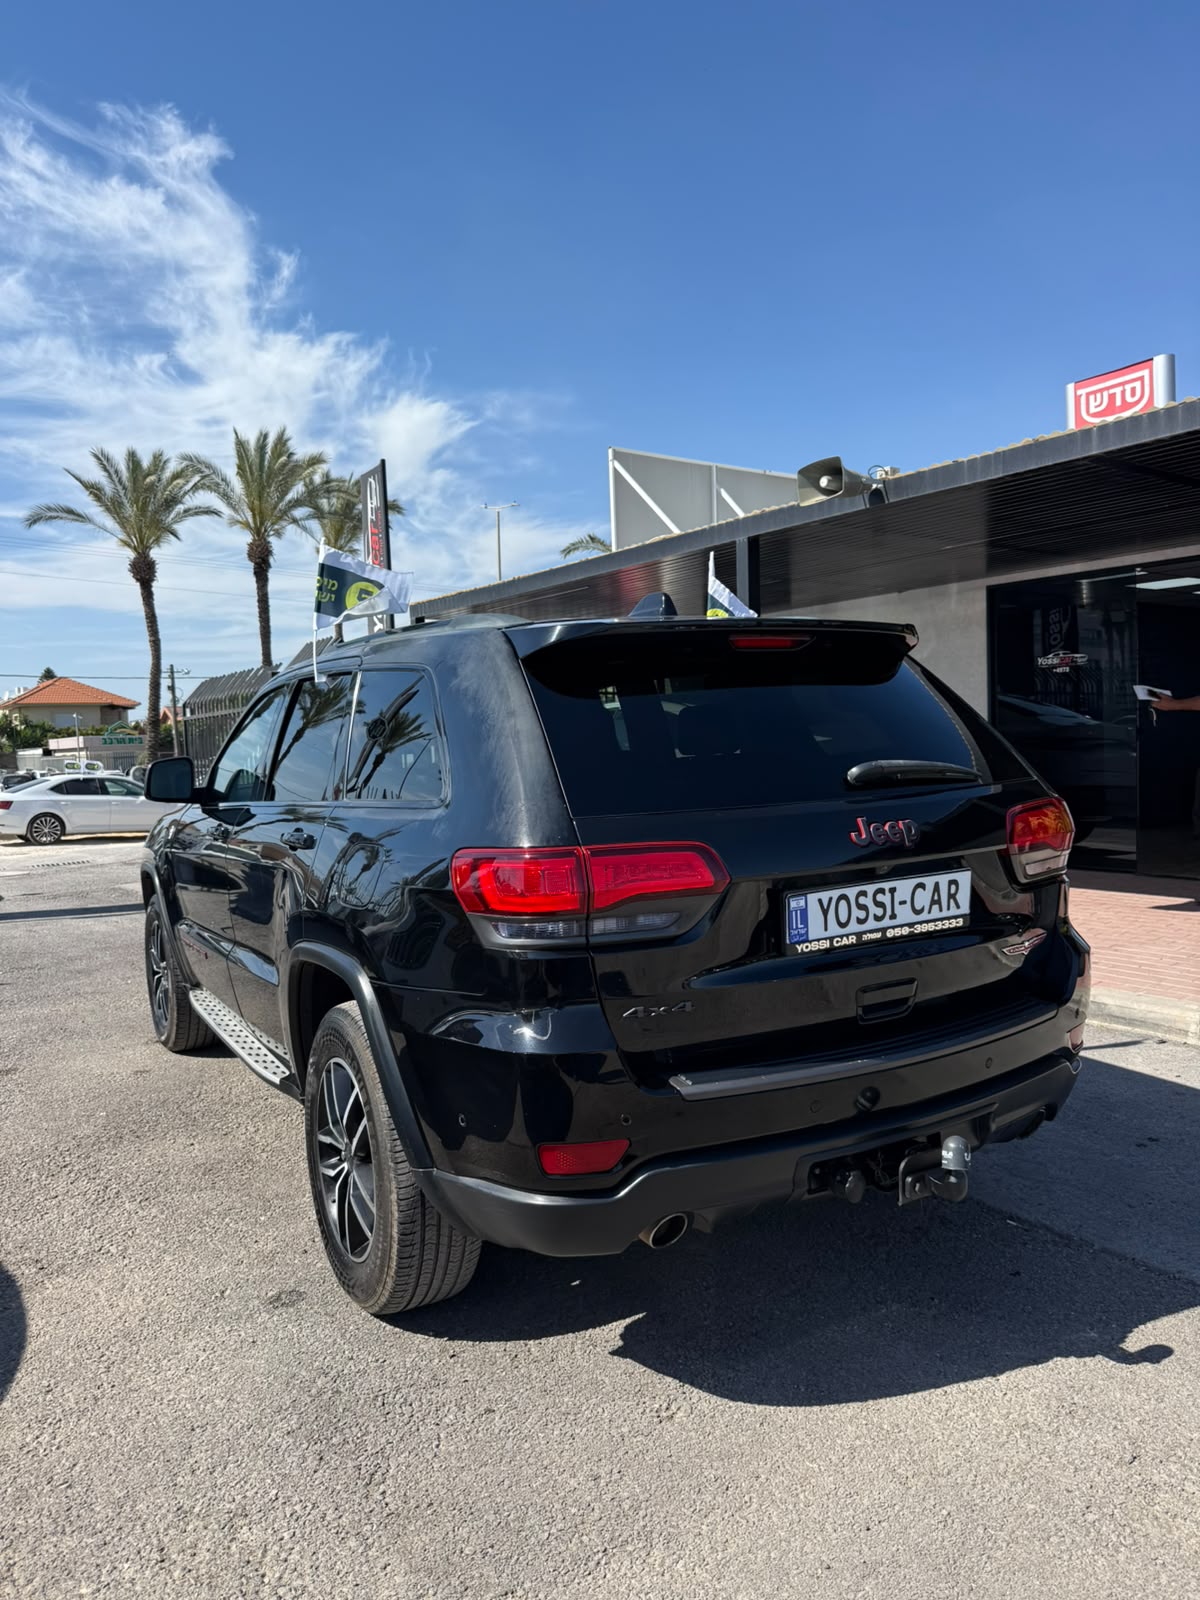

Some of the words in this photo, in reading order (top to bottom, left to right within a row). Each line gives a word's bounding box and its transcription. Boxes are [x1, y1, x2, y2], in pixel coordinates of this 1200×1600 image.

[1088, 380, 1142, 415] סדש
[848, 816, 920, 848] Jeep
[792, 909, 805, 929] IL
[817, 878, 961, 932] YOSSI-CAR
[795, 939, 830, 953] YOSSI
[833, 935, 857, 947] CAR
[886, 918, 964, 938] 050-3953333
